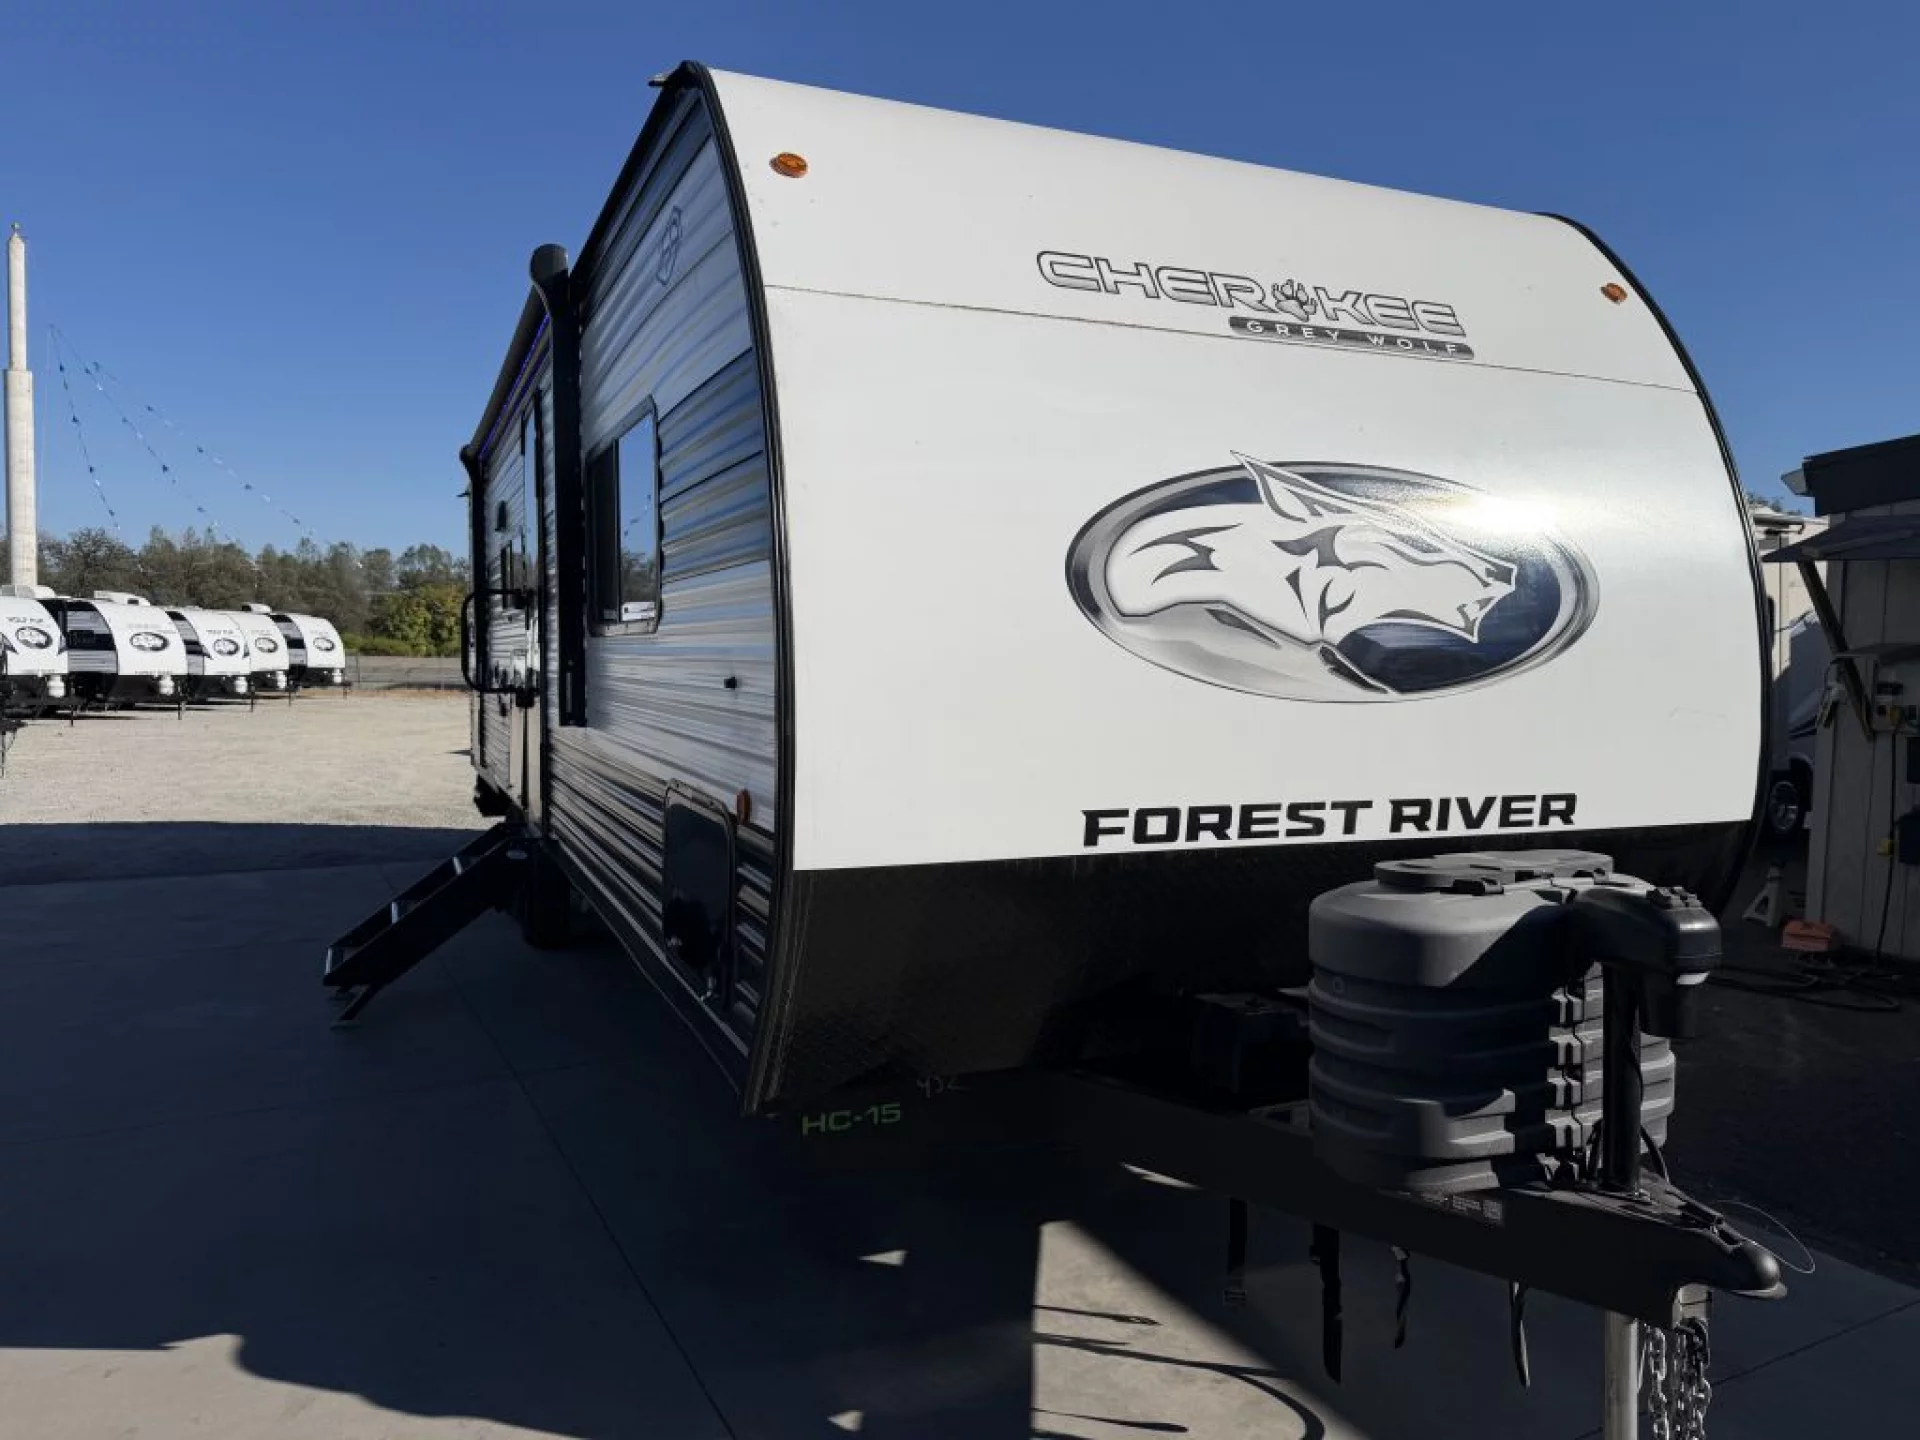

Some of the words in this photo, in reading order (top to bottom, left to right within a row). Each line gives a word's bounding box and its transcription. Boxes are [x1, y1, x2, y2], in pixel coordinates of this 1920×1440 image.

[1036, 250, 1466, 337] CHEROKEE
[1246, 319, 1341, 342] GREY
[1366, 332, 1458, 356] WOLF
[1081, 799, 1373, 847] FOREST
[1388, 792, 1577, 833] RIVER
[802, 1102, 902, 1137] HC-15
